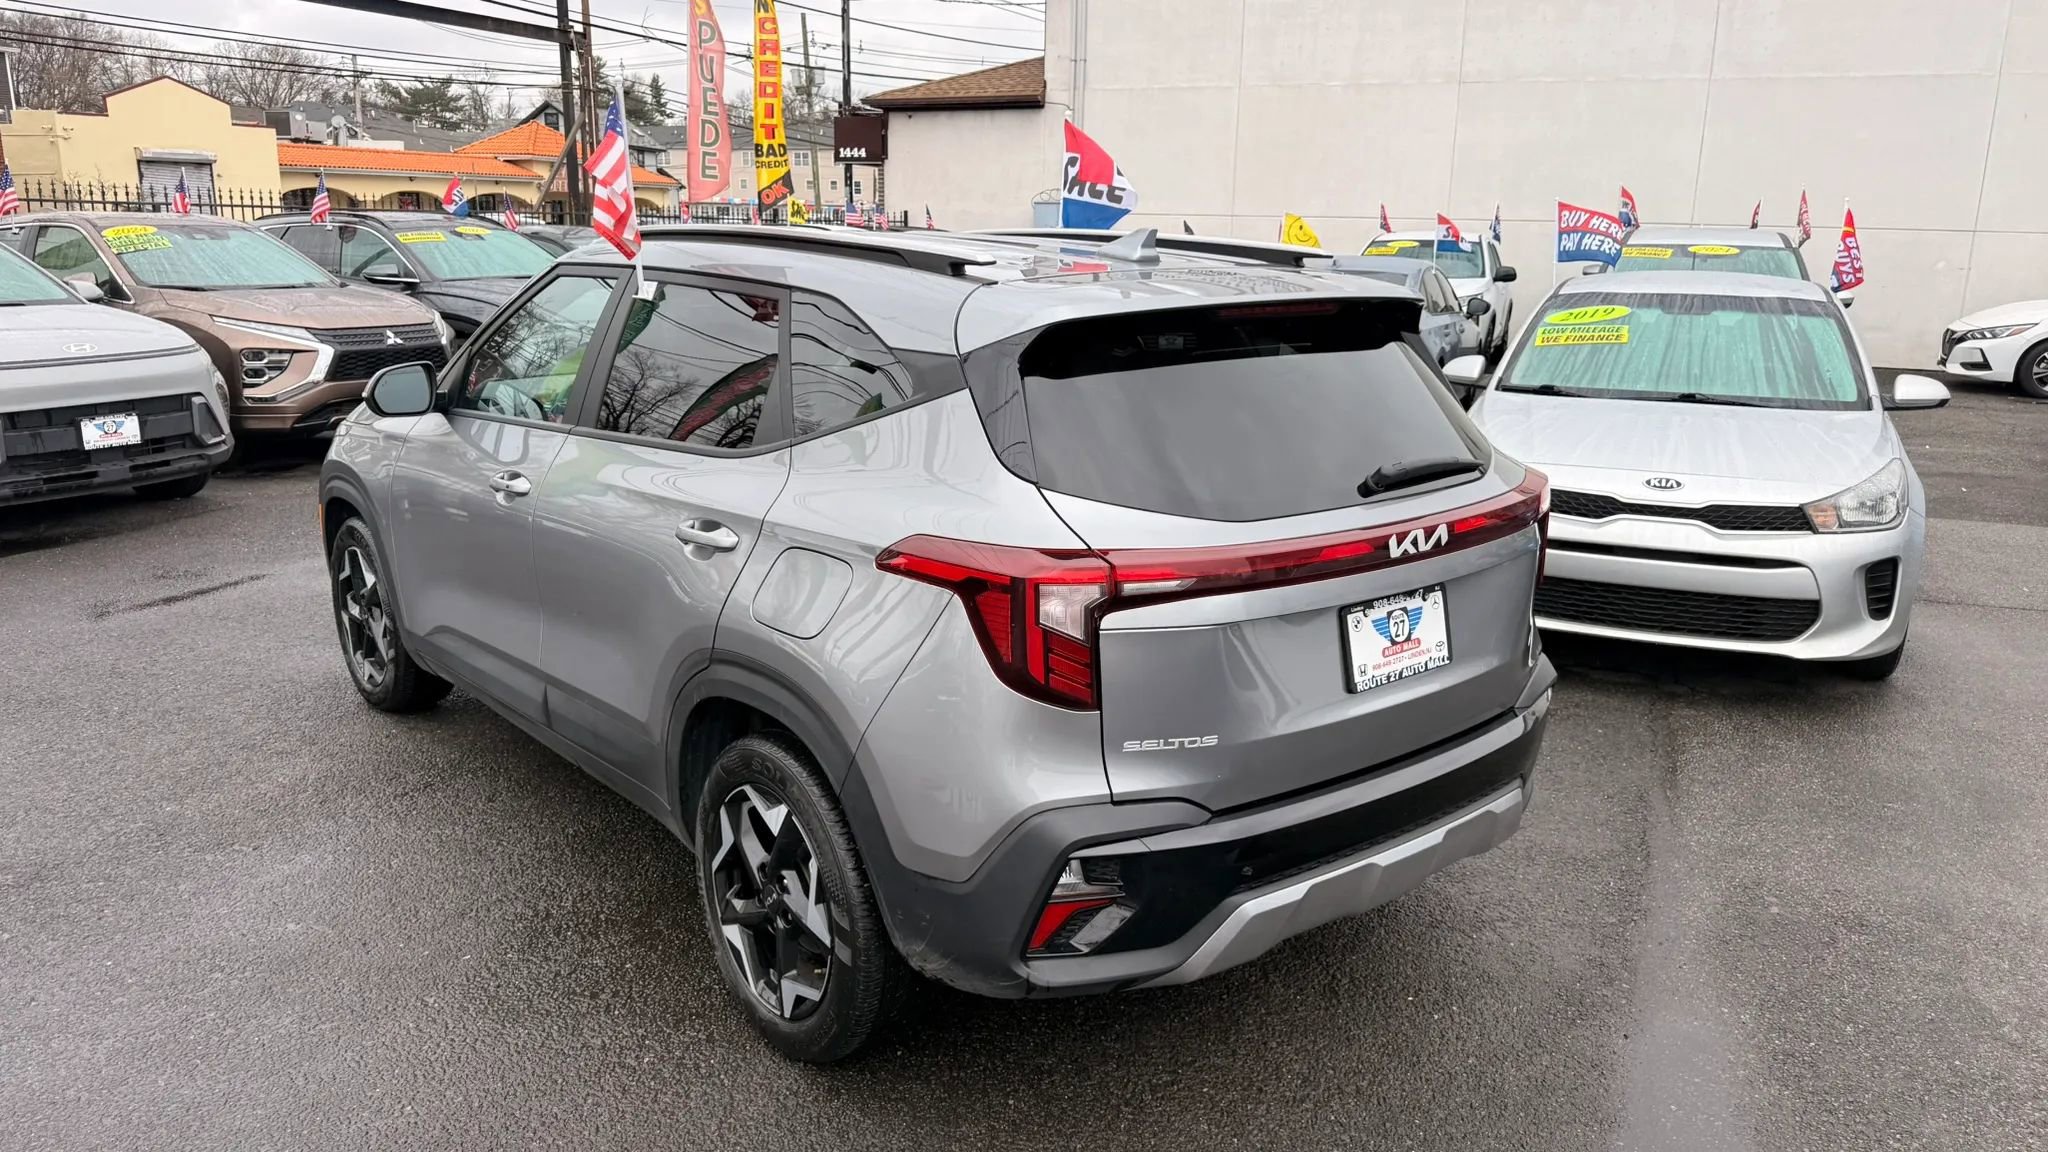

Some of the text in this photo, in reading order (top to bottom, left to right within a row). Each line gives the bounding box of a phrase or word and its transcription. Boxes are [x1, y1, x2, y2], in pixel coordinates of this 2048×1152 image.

[759, 17, 778, 140] CREDIT
[698, 20, 720, 180] PUEDE
[755, 143, 787, 158] BAD
[839, 147, 867, 158] 1444
[755, 159, 788, 169] CREDIT
[761, 180, 789, 205] OK
[1561, 210, 1625, 240] BUY HERE
[1560, 232, 1620, 257] PAY HERE
[1845, 237, 1863, 278] BEST
[1559, 307, 1615, 322] 2019
[1540, 334, 1624, 344] WE FINANCE
[1541, 326, 1624, 335] LOW MILEAGE
[1650, 478, 1677, 488] KIA
[1388, 523, 1449, 558] KIA
[1391, 613, 1405, 621] ROUTE
[1393, 620, 1406, 639] 27
[1384, 640, 1420, 656] AUTO MALL
[1356, 655, 1450, 692] ROUTE 27 AUTO MALL
[1122, 734, 1219, 753] SELTOS
